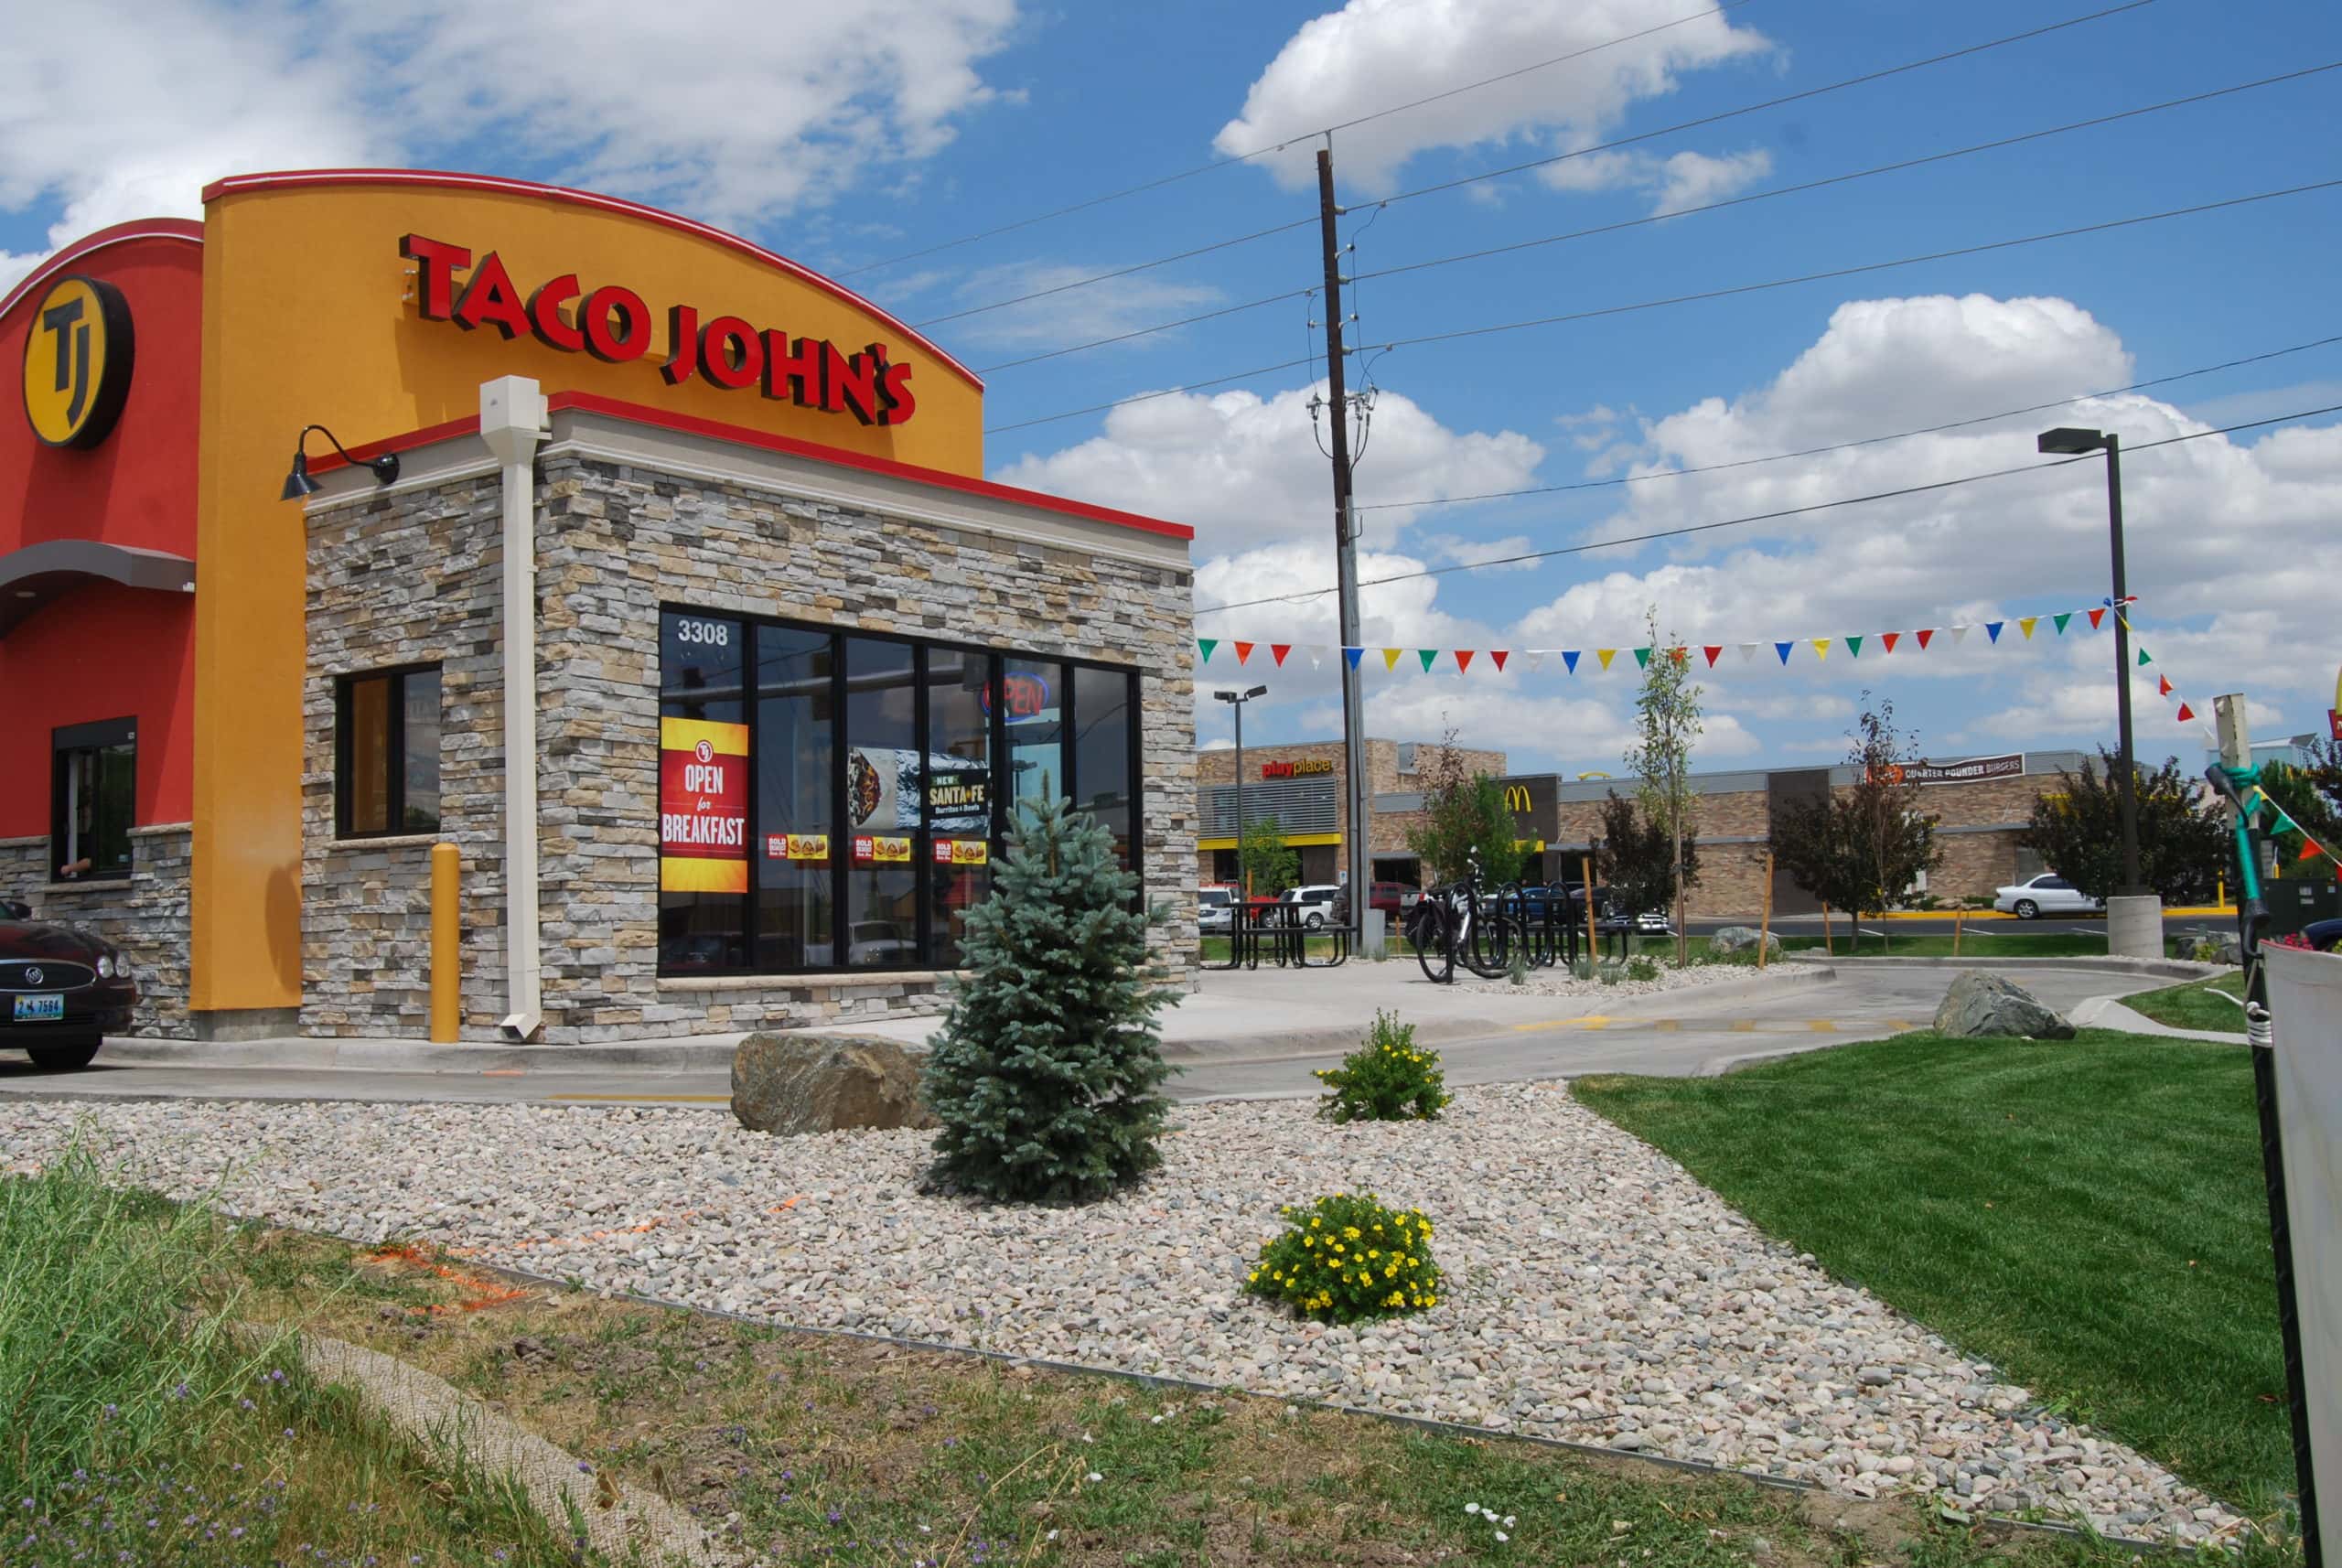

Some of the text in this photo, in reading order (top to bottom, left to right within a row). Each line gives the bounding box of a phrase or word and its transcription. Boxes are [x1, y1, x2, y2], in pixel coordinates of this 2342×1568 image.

[399, 232, 916, 426] TACO JOHN'S
[43, 295, 91, 430] TJ
[678, 619, 728, 646] 3308
[684, 764, 724, 794] OPEN
[936, 776, 953, 786] NEW
[1944, 765, 1984, 777] POUNDER
[696, 796, 711, 811] for
[929, 784, 984, 806] SANTA FE
[661, 813, 745, 845] BREAKFAST
